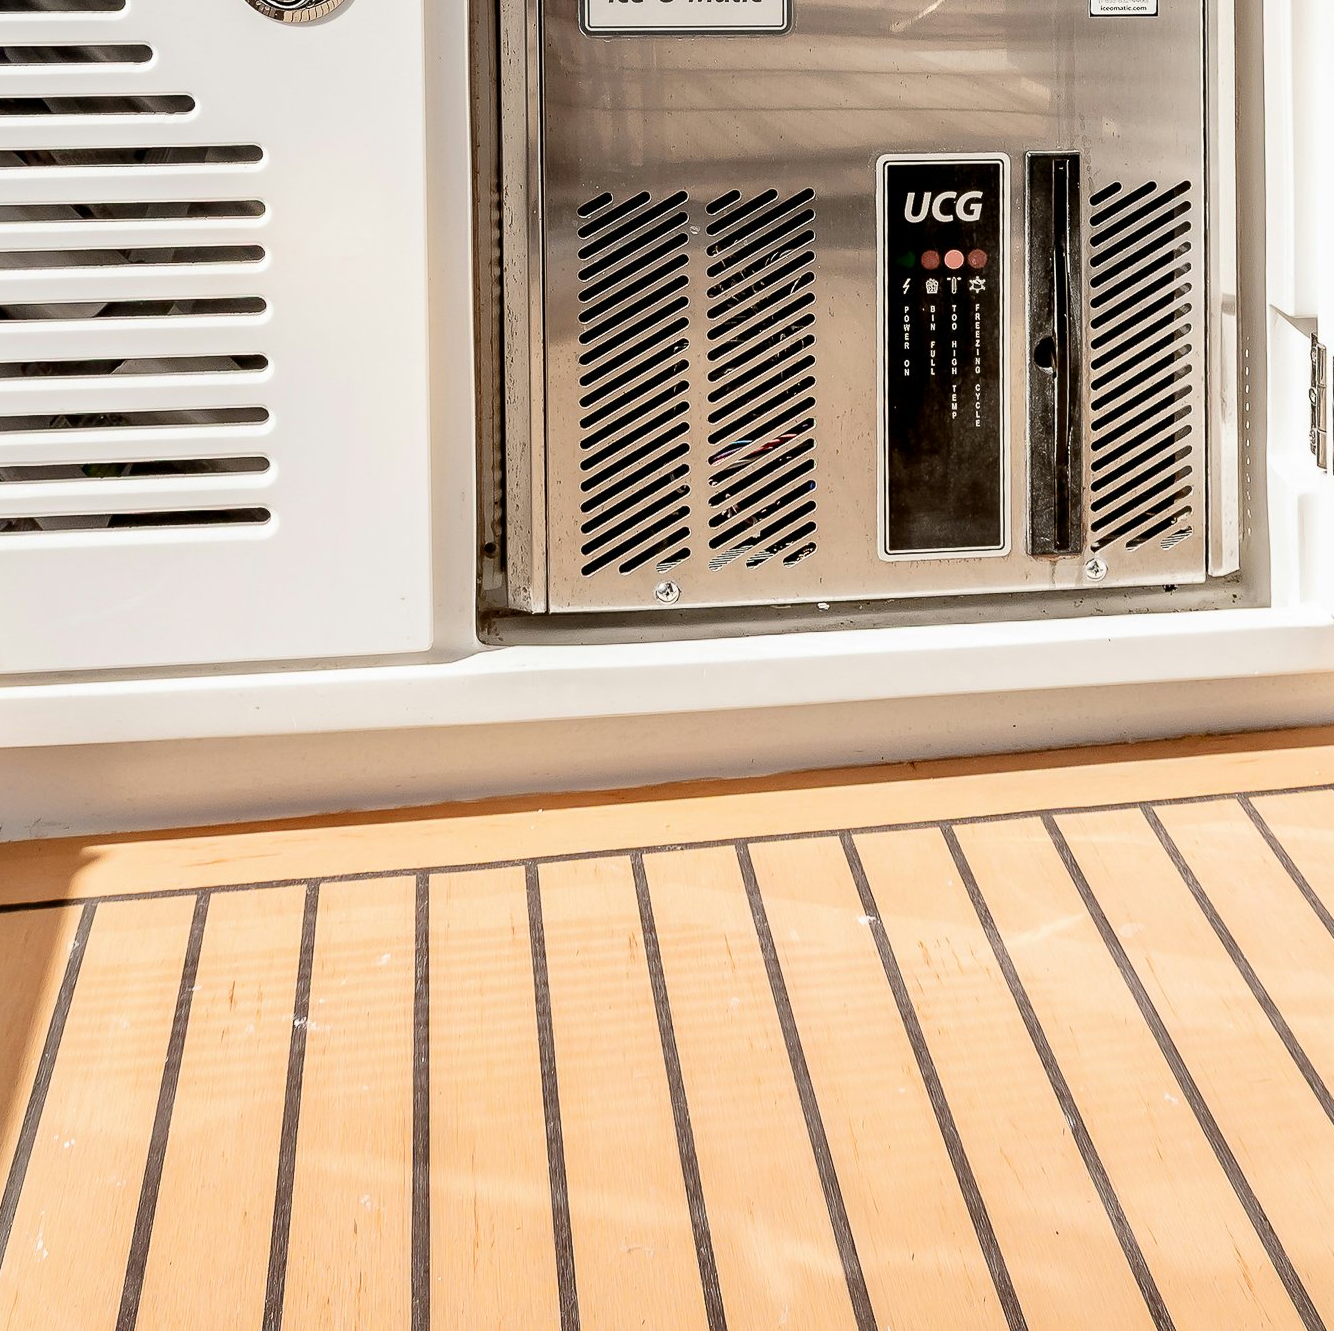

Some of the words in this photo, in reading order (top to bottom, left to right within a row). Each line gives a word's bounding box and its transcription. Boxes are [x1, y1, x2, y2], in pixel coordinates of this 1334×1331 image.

[904, 191, 983, 223] UCG
[903, 306, 911, 350] POWER
[904, 360, 910, 376] ON
